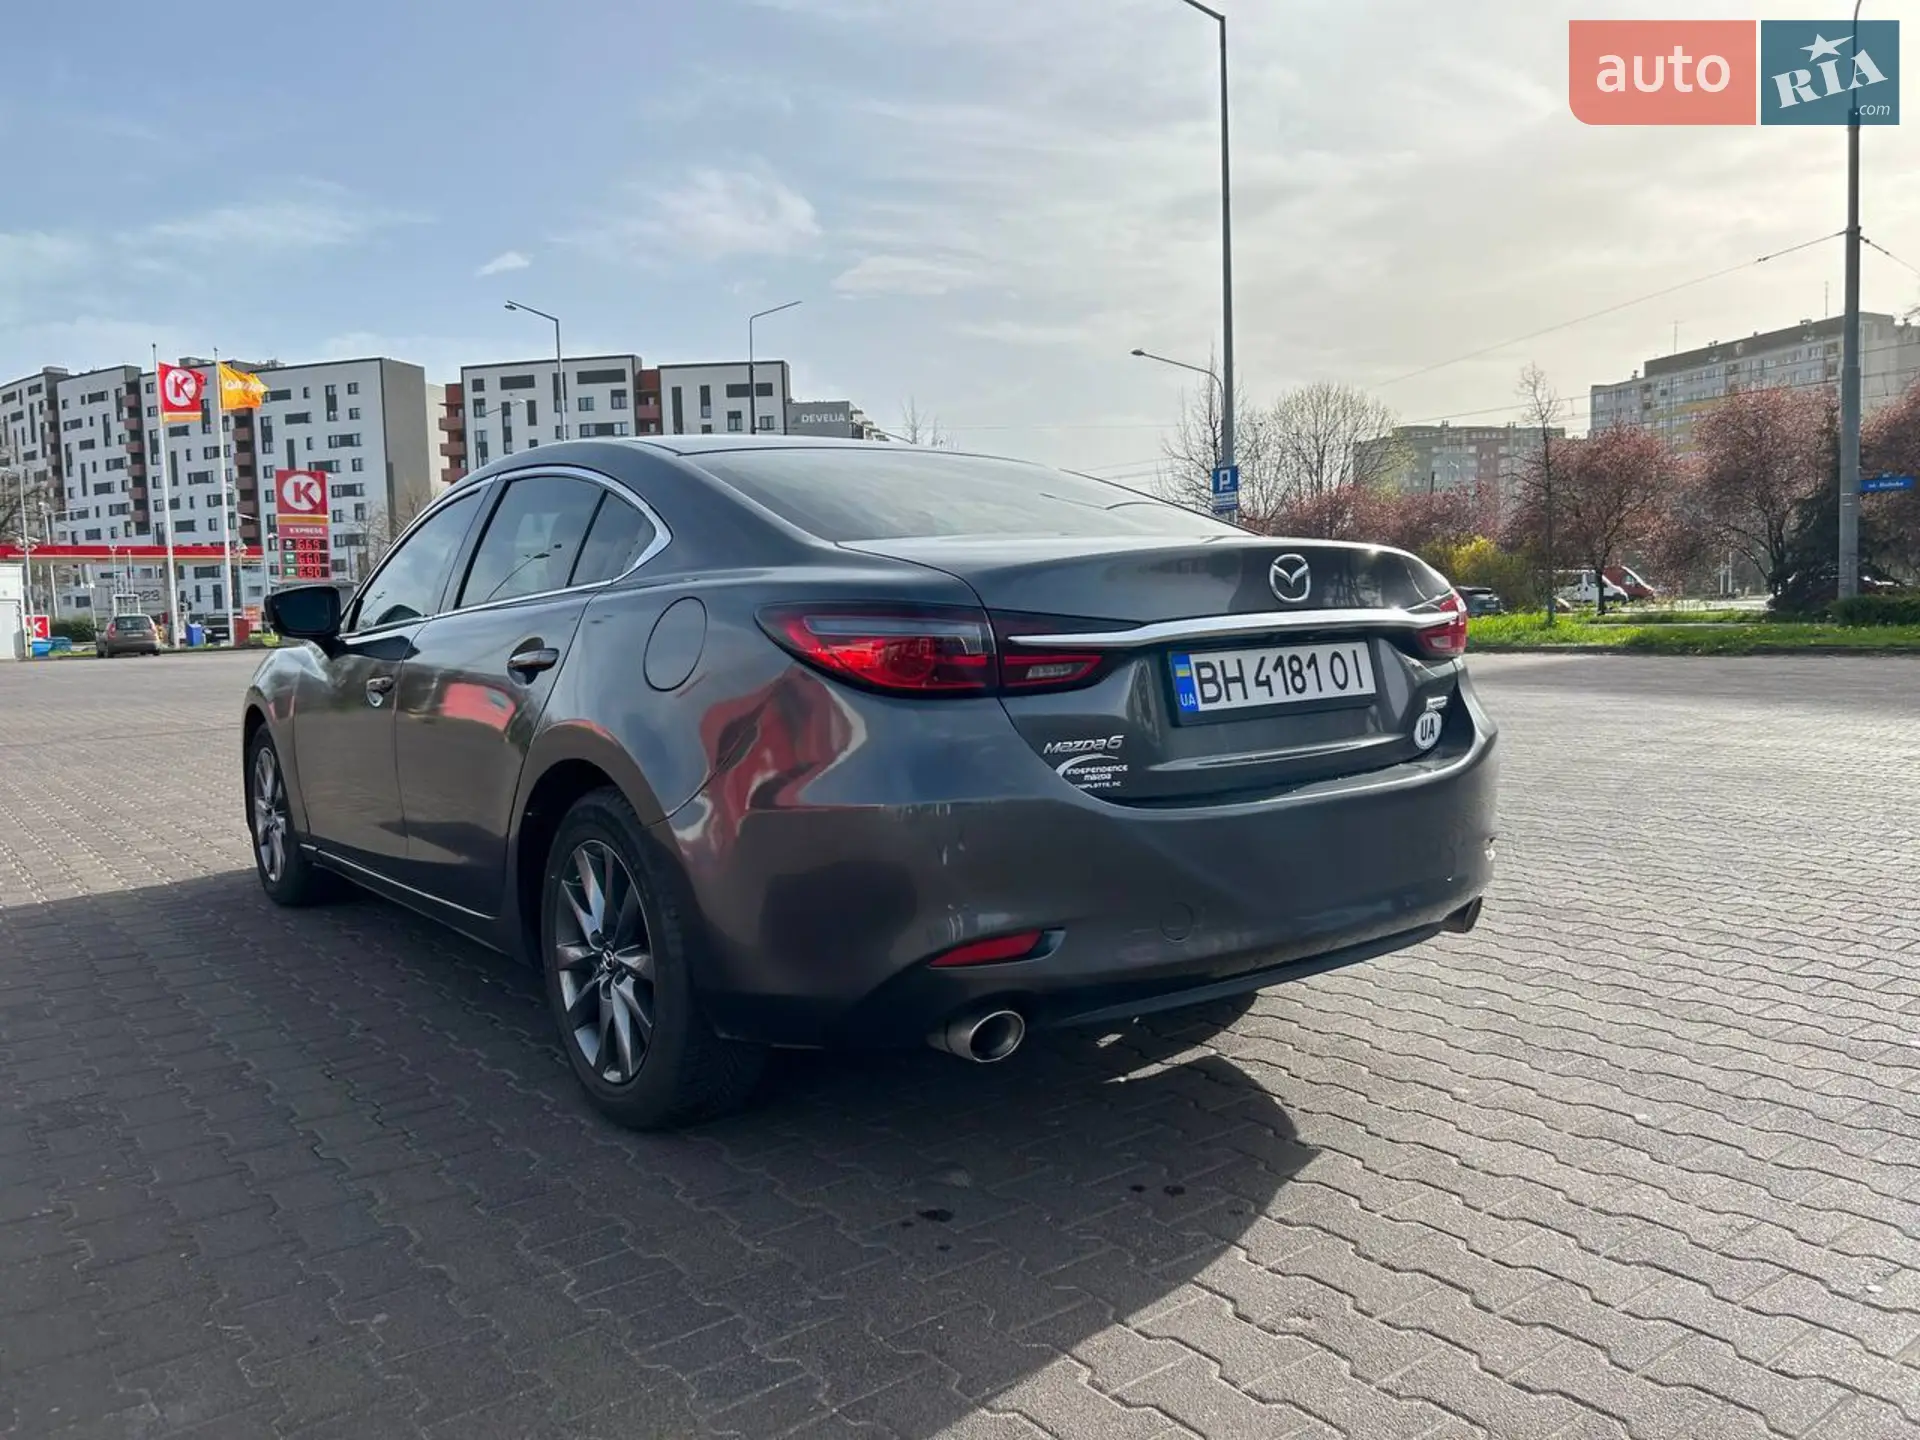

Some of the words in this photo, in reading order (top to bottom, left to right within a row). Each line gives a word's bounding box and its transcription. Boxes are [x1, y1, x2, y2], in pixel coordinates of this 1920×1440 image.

[801, 412, 846, 423] DEVELIA
[1219, 469, 1231, 491] P
[1195, 658, 1248, 704] BH
[1254, 652, 1323, 697] 4181
[1180, 693, 1196, 707] UA
[1421, 717, 1435, 741] UA
